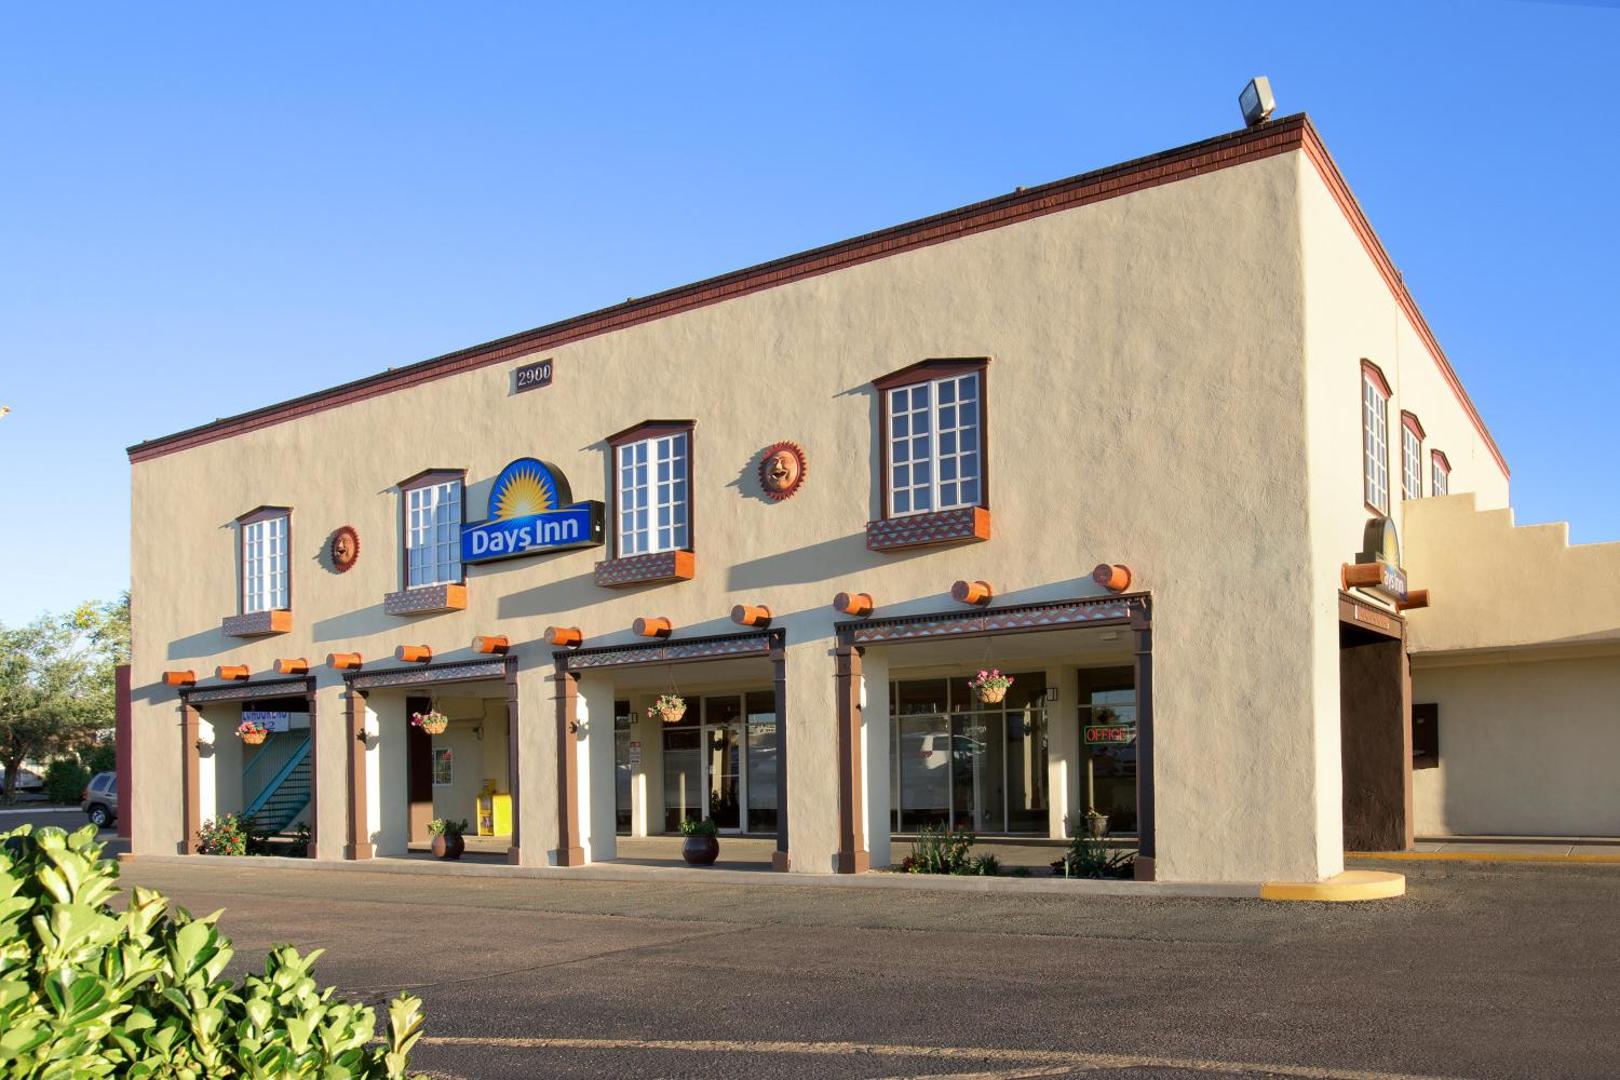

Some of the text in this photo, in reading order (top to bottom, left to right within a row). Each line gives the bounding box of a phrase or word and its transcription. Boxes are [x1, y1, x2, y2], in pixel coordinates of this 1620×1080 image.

[518, 364, 550, 386] 2900
[472, 518, 578, 554] Days Inn
